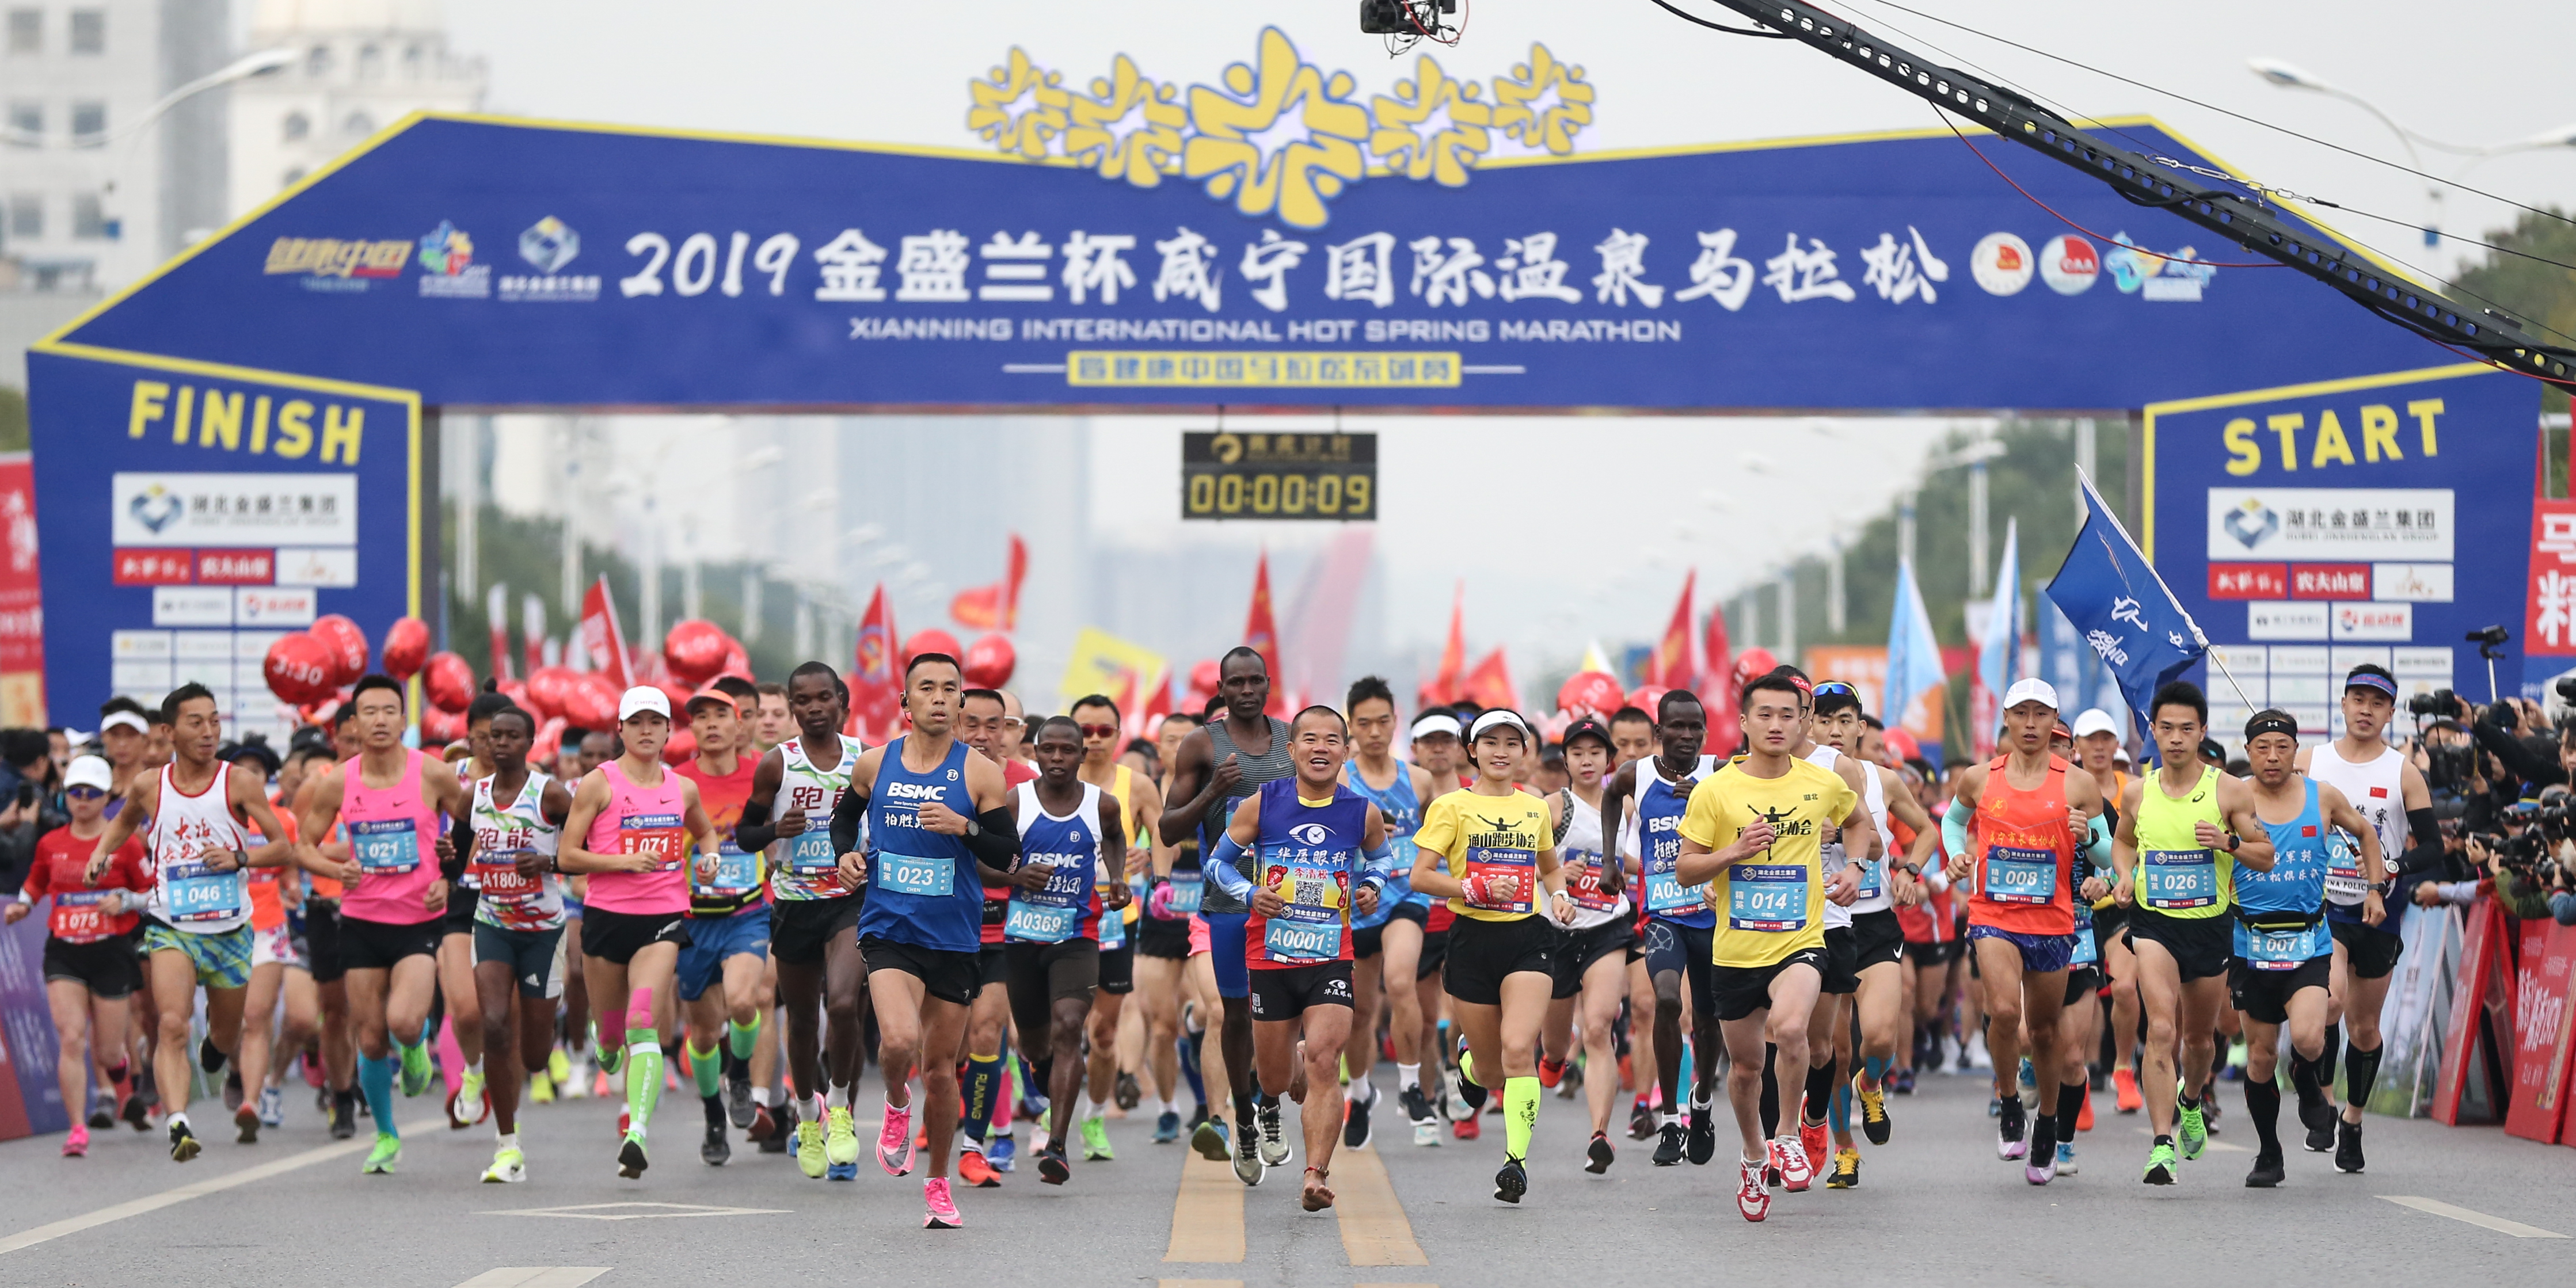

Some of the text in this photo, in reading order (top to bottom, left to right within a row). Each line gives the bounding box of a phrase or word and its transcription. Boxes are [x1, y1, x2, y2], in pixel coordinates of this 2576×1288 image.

[621, 224, 1950, 312] 2019 金盛兰杯咸宁国际温泉马拉松
[849, 317, 1681, 344] XIANNING INTERNATIONAL HOT SPRING MARATHON
[128, 380, 365, 467] FINISH
[2223, 398, 2445, 477] START
[1190, 474, 1371, 514] 00:00:09
[2286, 508, 2436, 529] 湖北金盛兰集团
[272, 654, 325, 686] 3:30
[886, 782, 948, 801] BSMC
[1649, 814, 1686, 833] BSM
[1736, 819, 1812, 839] 步协会
[639, 836, 668, 853] 071
[796, 840, 834, 858] A03
[1467, 832, 1536, 848] 通山跑步协会
[1654, 838, 1683, 860] 柏胜
[368, 841, 399, 859] 021
[1028, 852, 1084, 868] BSMC
[896, 866, 935, 886] 023
[1580, 875, 1602, 893] 07
[2005, 870, 2038, 886] 008
[2164, 874, 2197, 890] 026
[188, 885, 220, 904] 046
[1751, 891, 1787, 910] 014
[1009, 910, 1062, 933] A0369
[1268, 927, 1326, 950] A0001
[2266, 938, 2299, 952] 007
[971, 1073, 988, 1120] RUNNING
